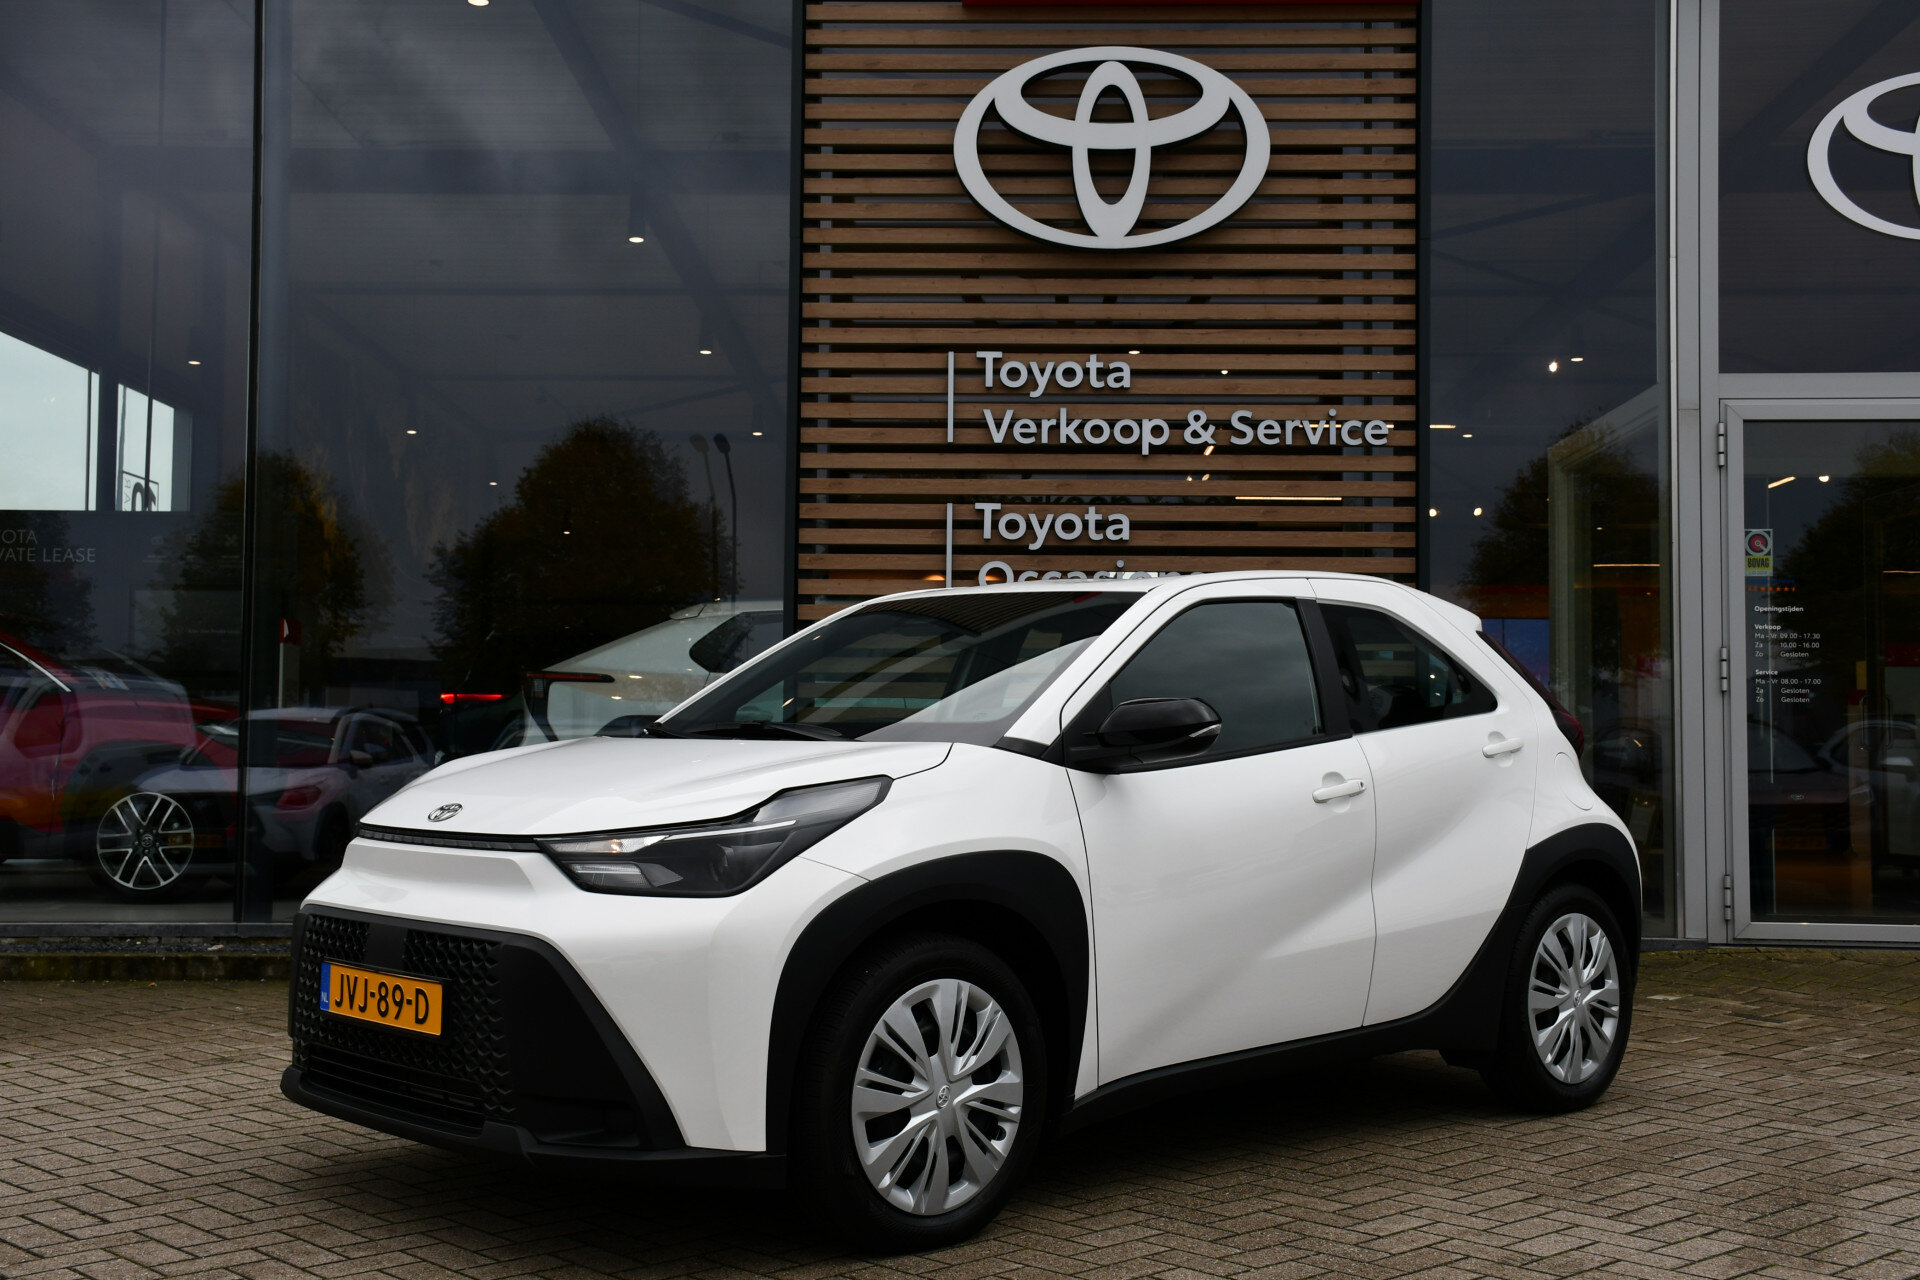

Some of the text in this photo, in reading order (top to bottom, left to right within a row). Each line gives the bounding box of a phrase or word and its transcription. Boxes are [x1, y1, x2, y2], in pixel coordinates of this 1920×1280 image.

[976, 350, 1131, 398] Toyota
[982, 407, 1390, 456] Verkoop & Service
[974, 502, 1130, 551] Toyota
[43, 548, 96, 563] LEASE
[1747, 557, 1770, 568] BOVAG
[1754, 605, 1804, 613] Openingstijden
[1754, 623, 1782, 631] Verkoop
[321, 991, 329, 1003] NL
[335, 973, 430, 1025] JVJ-89-D
